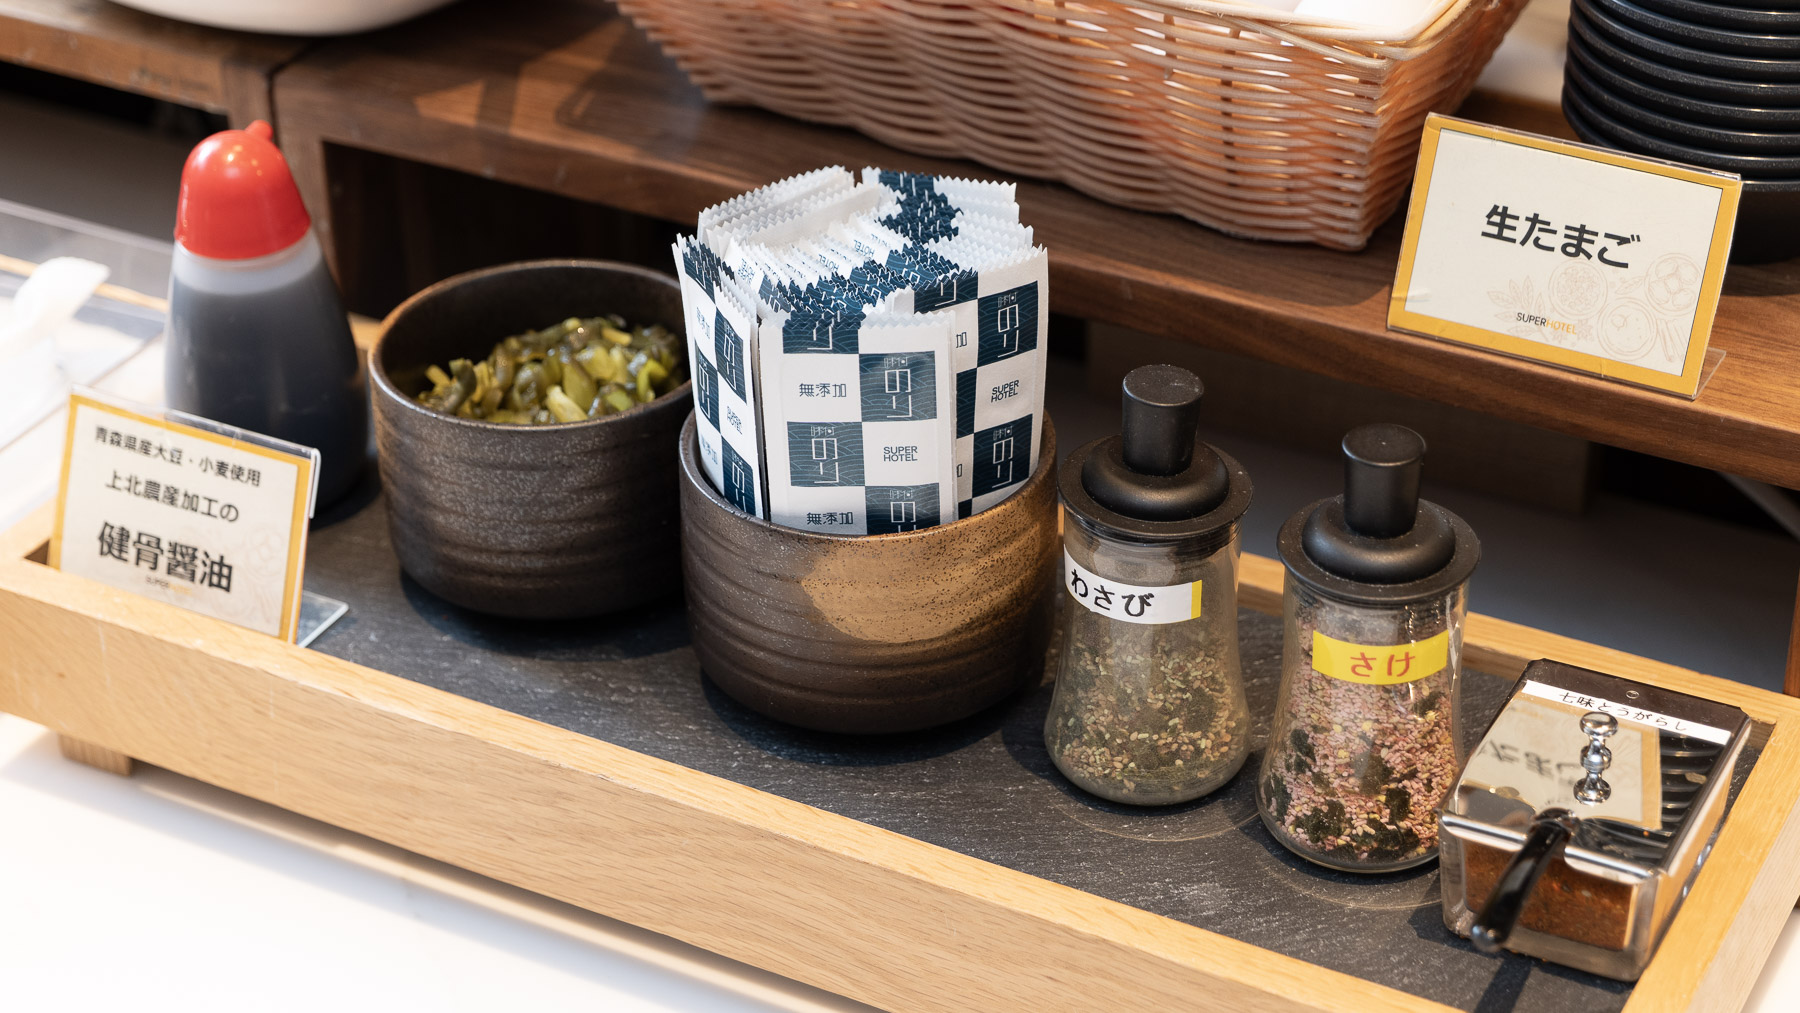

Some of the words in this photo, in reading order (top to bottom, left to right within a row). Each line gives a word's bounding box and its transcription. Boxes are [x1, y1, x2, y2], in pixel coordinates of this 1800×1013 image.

[1480, 204, 1641, 269] 生たまご
[799, 382, 847, 398] 無添加
[990, 388, 1018, 403] HOTEL
[991, 379, 1020, 395] SUPER
[95, 425, 262, 488] 青森県産大豆・小麦使用
[883, 445, 918, 455] SUPER
[883, 453, 918, 462] HOTEL
[105, 469, 240, 523] 上北農産加工の
[806, 511, 854, 525] 無添加
[1071, 568, 1155, 618] わさび
[1350, 651, 1416, 678] さけ
[1559, 691, 1687, 731] 七味とうがらし
